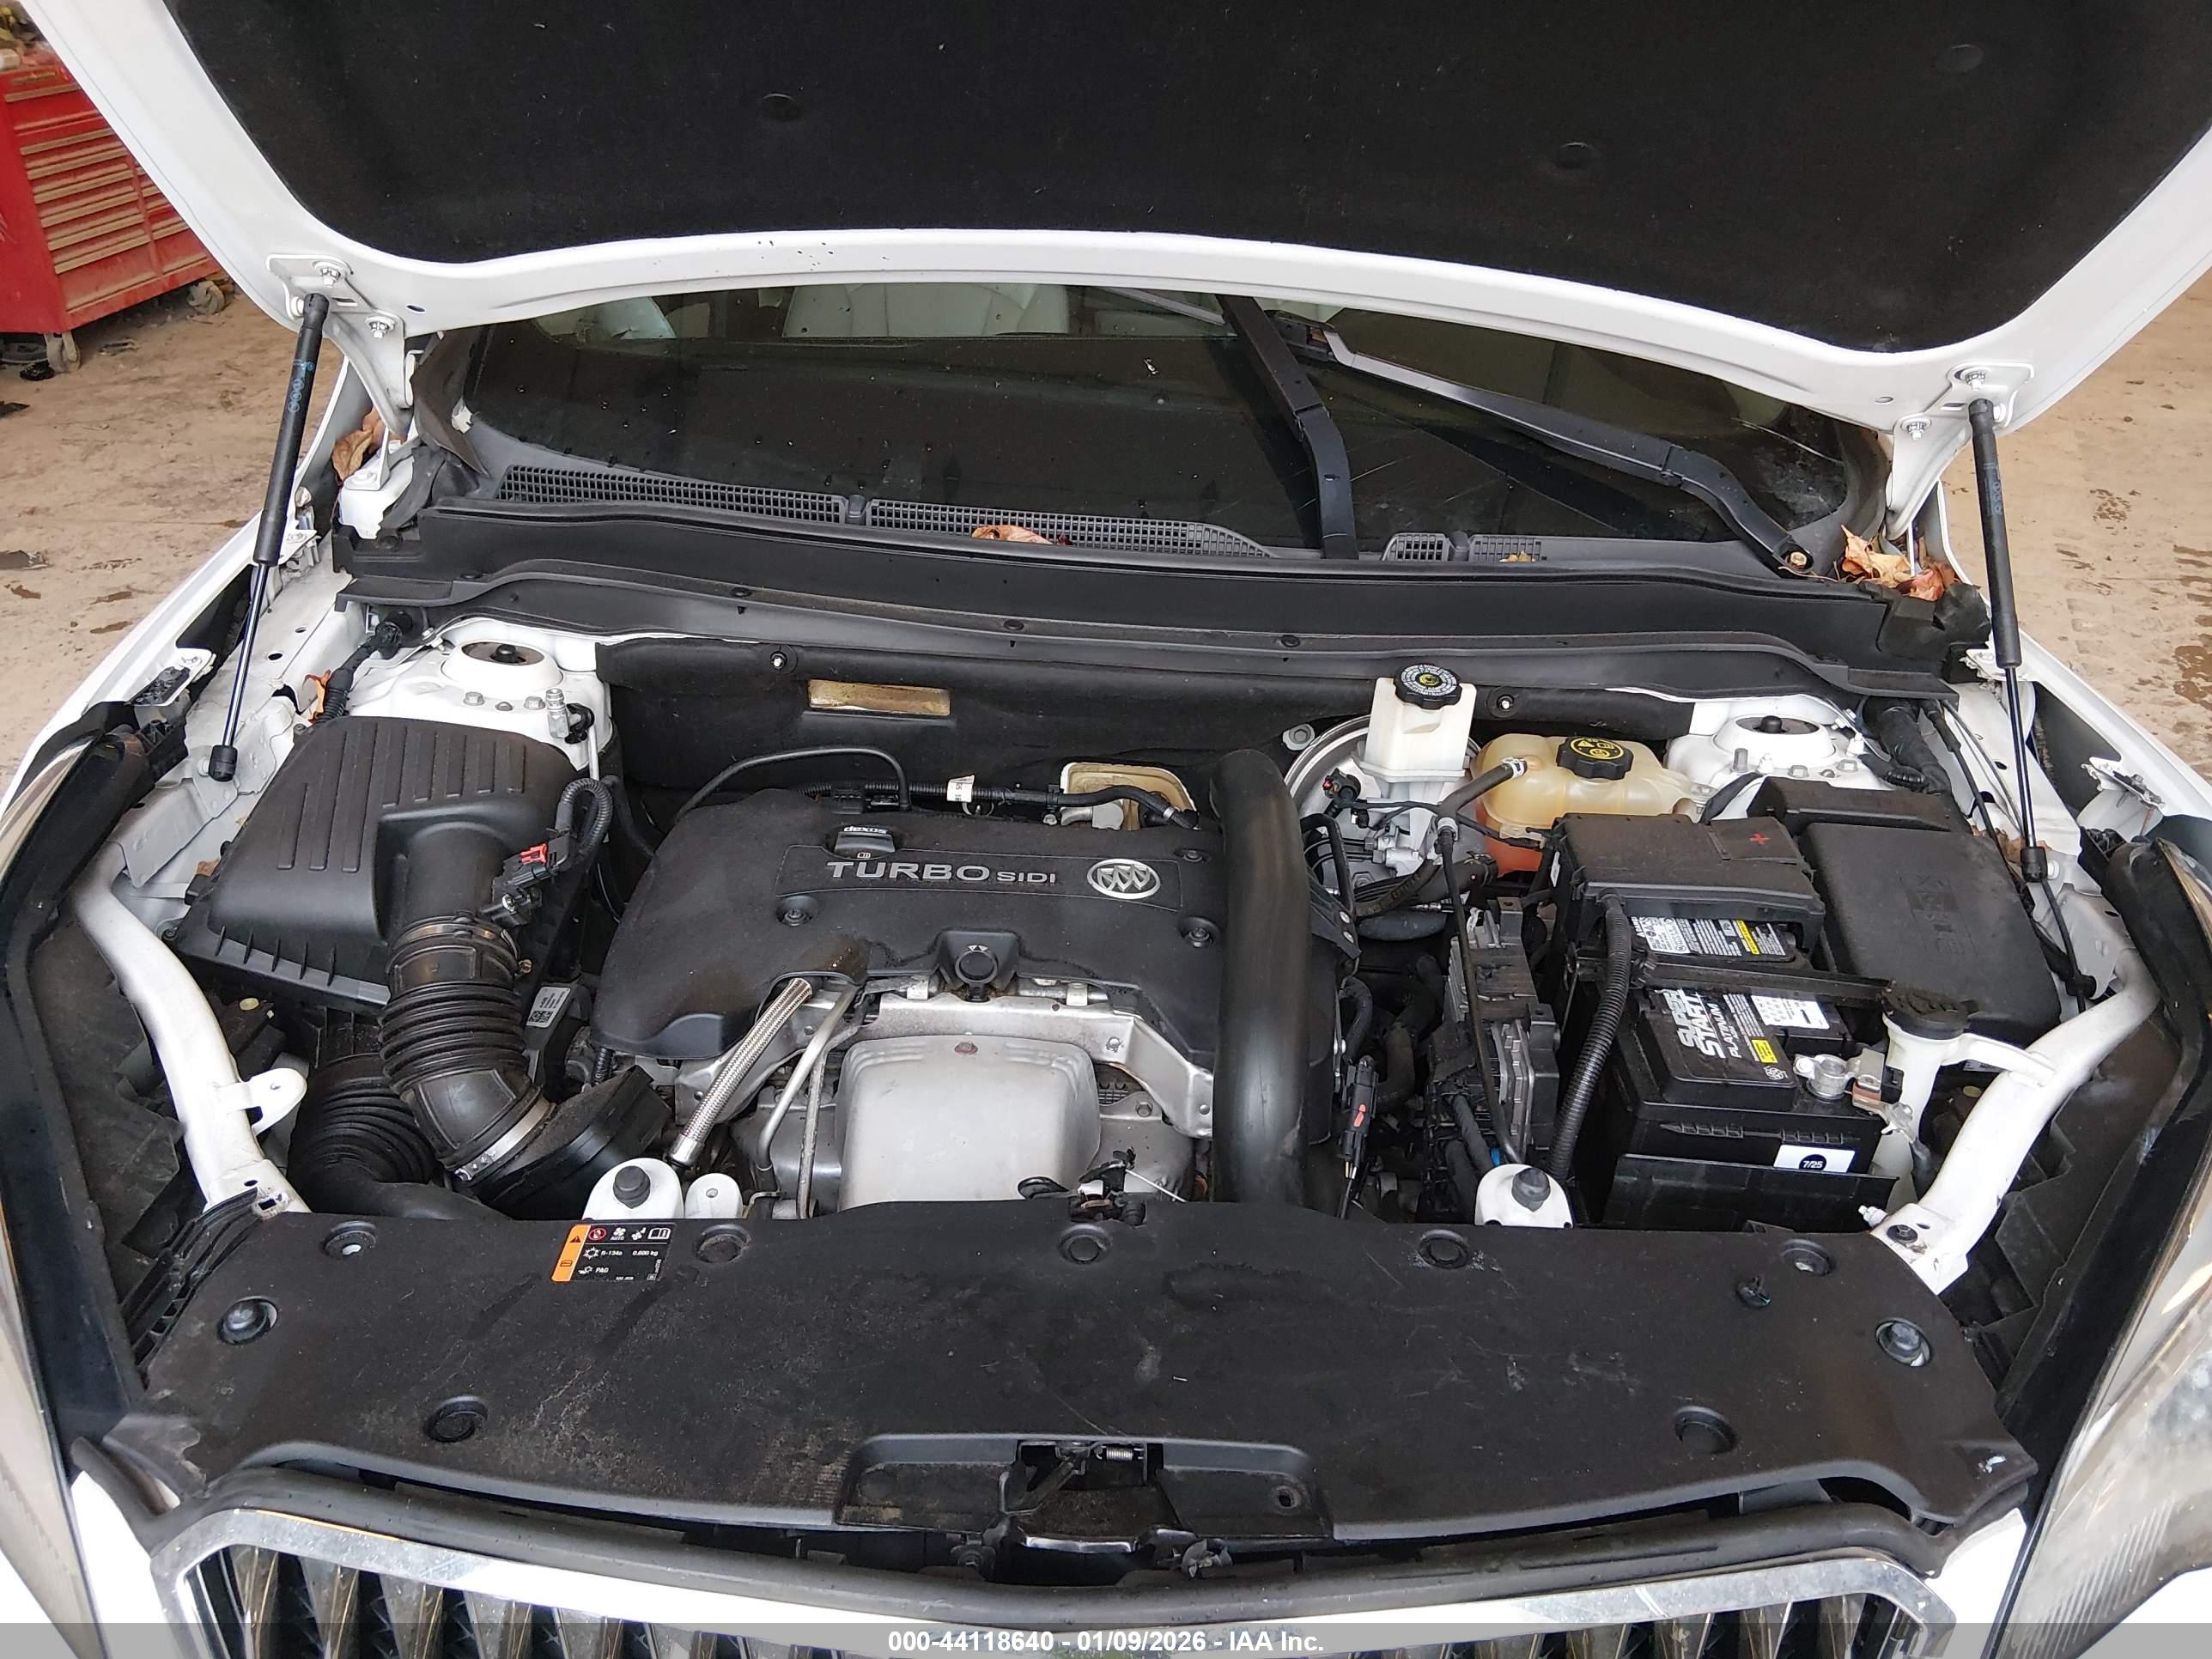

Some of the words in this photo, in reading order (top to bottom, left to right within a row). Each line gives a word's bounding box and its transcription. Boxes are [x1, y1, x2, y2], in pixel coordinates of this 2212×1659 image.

[843, 825, 888, 835] dexos
[827, 861, 990, 881] TURBO
[996, 872, 1056, 883] SIDI
[1677, 988, 1726, 1059] START
[1707, 1003, 1742, 1058] PLATINUM
[1802, 1160, 1824, 1169] 7/25
